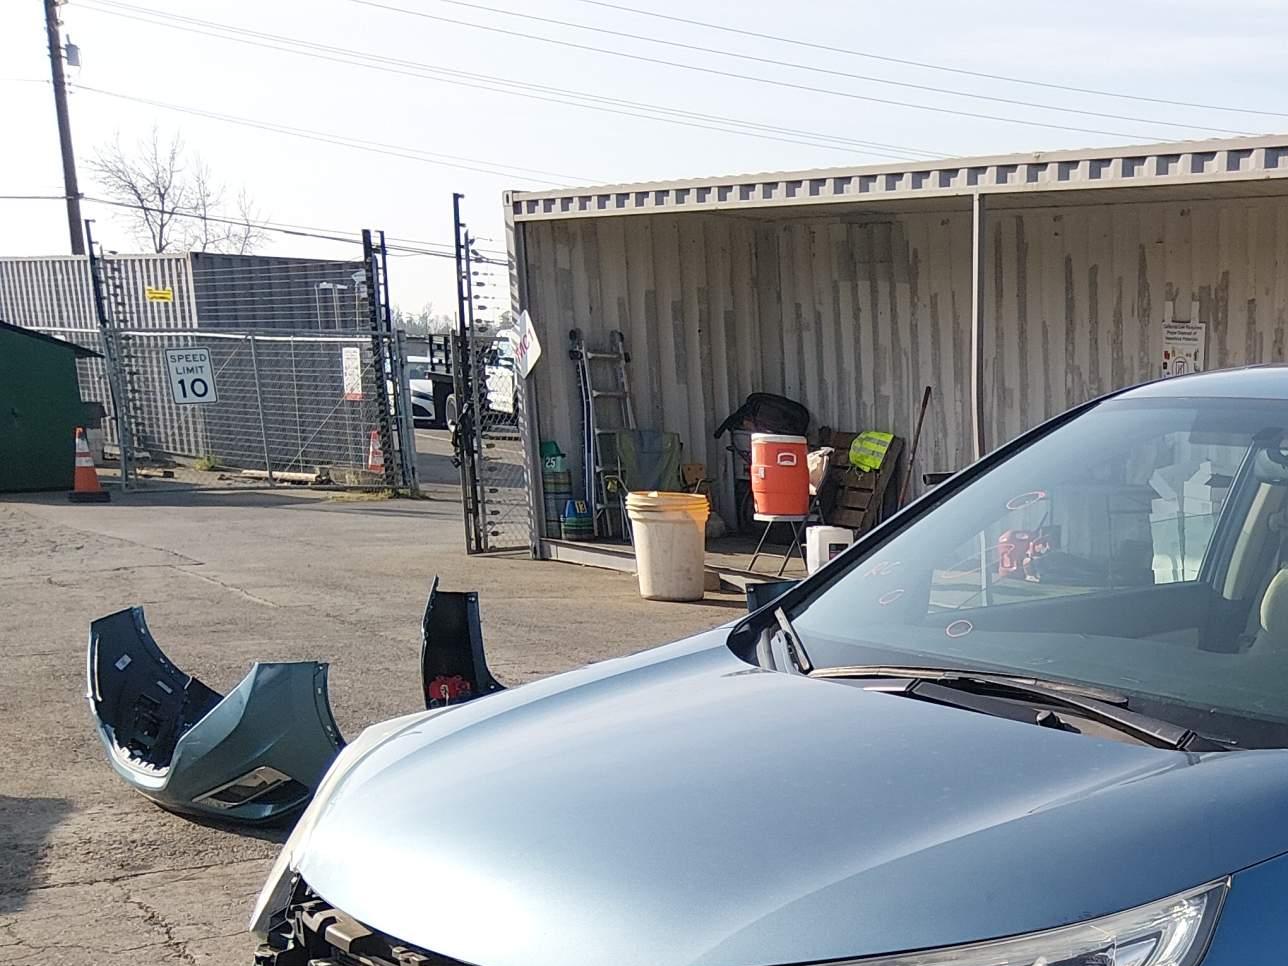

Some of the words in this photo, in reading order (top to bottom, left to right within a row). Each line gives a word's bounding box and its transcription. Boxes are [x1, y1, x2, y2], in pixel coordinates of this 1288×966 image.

[169, 353, 207, 363] SPEED
[175, 365, 205, 375] LIMIT
[177, 377, 208, 398] 10
[545, 456, 557, 468] 25
